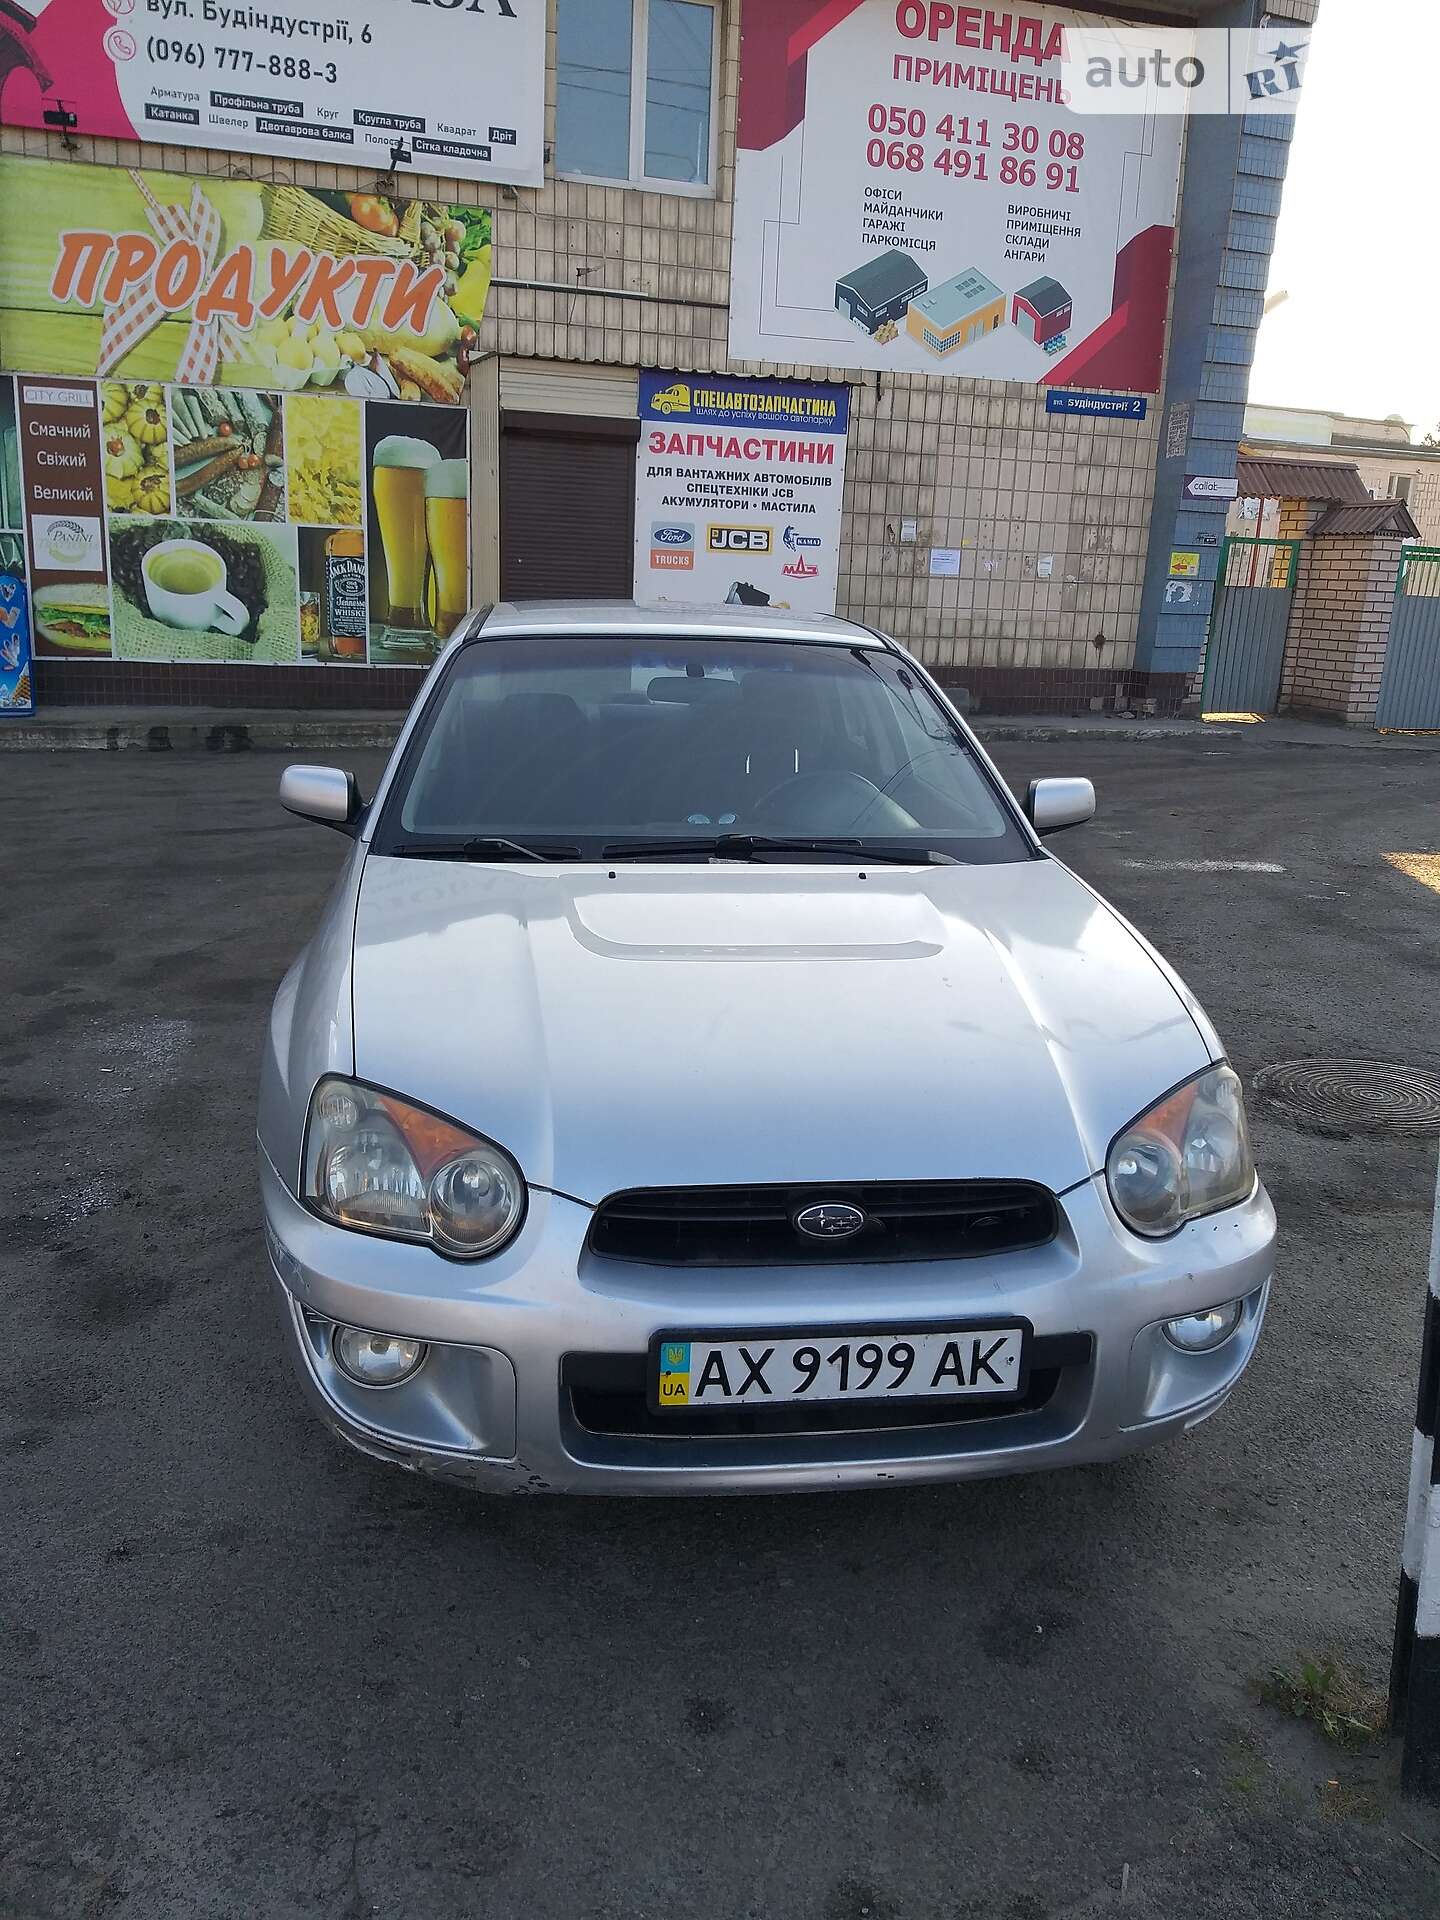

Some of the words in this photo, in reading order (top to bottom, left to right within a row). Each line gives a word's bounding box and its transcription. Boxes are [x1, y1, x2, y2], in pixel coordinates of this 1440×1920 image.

[203, 1, 353, 44] Будіндустрії,
[361, 24, 372, 43] 6
[896, 0, 1071, 66] ОРЕНДА
[147, 36, 205, 69] (096)
[214, 47, 337, 83] 777-888-3
[893, 54, 1072, 105] ПРИМІЩЕНЬ
[150, 86, 199, 101] Арматура
[214, 94, 270, 110] Профільна
[271, 104, 300, 116] труба
[316, 107, 339, 119] Круг
[358, 112, 391, 128] Кругла
[393, 119, 421, 132] труба
[437, 123, 477, 136] Квадрат
[491, 130, 512, 142] Дріт
[150, 107, 194, 121] Катанка
[208, 114, 248, 128] Швелер
[259, 120, 320, 137] Двотаврова
[322, 127, 351, 141] балка
[415, 139, 441, 152] Сітка
[443, 144, 488, 158] кладочна
[868, 103, 926, 138] 050
[936, 114, 991, 147] 411
[1002, 123, 1039, 154] 30
[1048, 129, 1085, 160] 08
[866, 138, 924, 172] 068
[933, 148, 989, 181] 491
[1000, 156, 1036, 187] 86
[1046, 162, 1080, 192] 91
[864, 187, 902, 201] ОФІСИ
[863, 202, 943, 221] МАЙДАНЧИКИ
[1007, 204, 1071, 222] ВИРОБНИЧІ
[862, 218, 906, 232] ГАРАЖІ
[1006, 219, 1081, 238] ПРИМІЩЕННЯ
[862, 233, 936, 251] ПАРКОМІСЦЯ
[1005, 234, 1050, 249] СКЛАДИ
[1004, 249, 1046, 263] АНГАРИ
[51, 229, 446, 337] ПРОДУКТИ
[693, 389, 836, 417] СПЕЦАВТОЗАПЧАСТИНА
[1132, 400, 1141, 412] 2
[29, 421, 91, 439] Смачний
[648, 431, 834, 464] ЗАПЧАСТИНИ
[37, 451, 86, 467] Свіжий
[647, 466, 672, 478] ДЛЯ
[676, 467, 750, 482] ВАНТАЖНИХ
[754, 472, 832, 487] АВТОМОБІЛІВ
[34, 485, 93, 501] Великий
[686, 482, 769, 497] СПЕЦТЕХНІКИ
[772, 487, 794, 499] JCB
[661, 495, 749, 510] АКУМУЛЯТОРИ
[761, 501, 816, 514] МАСТИЛА
[660, 530, 685, 543] Ford
[711, 530, 769, 550] JCB
[655, 555, 690, 566] TRUCKS
[792, 1342, 915, 1394] 9199
[662, 1383, 686, 1397] UA
